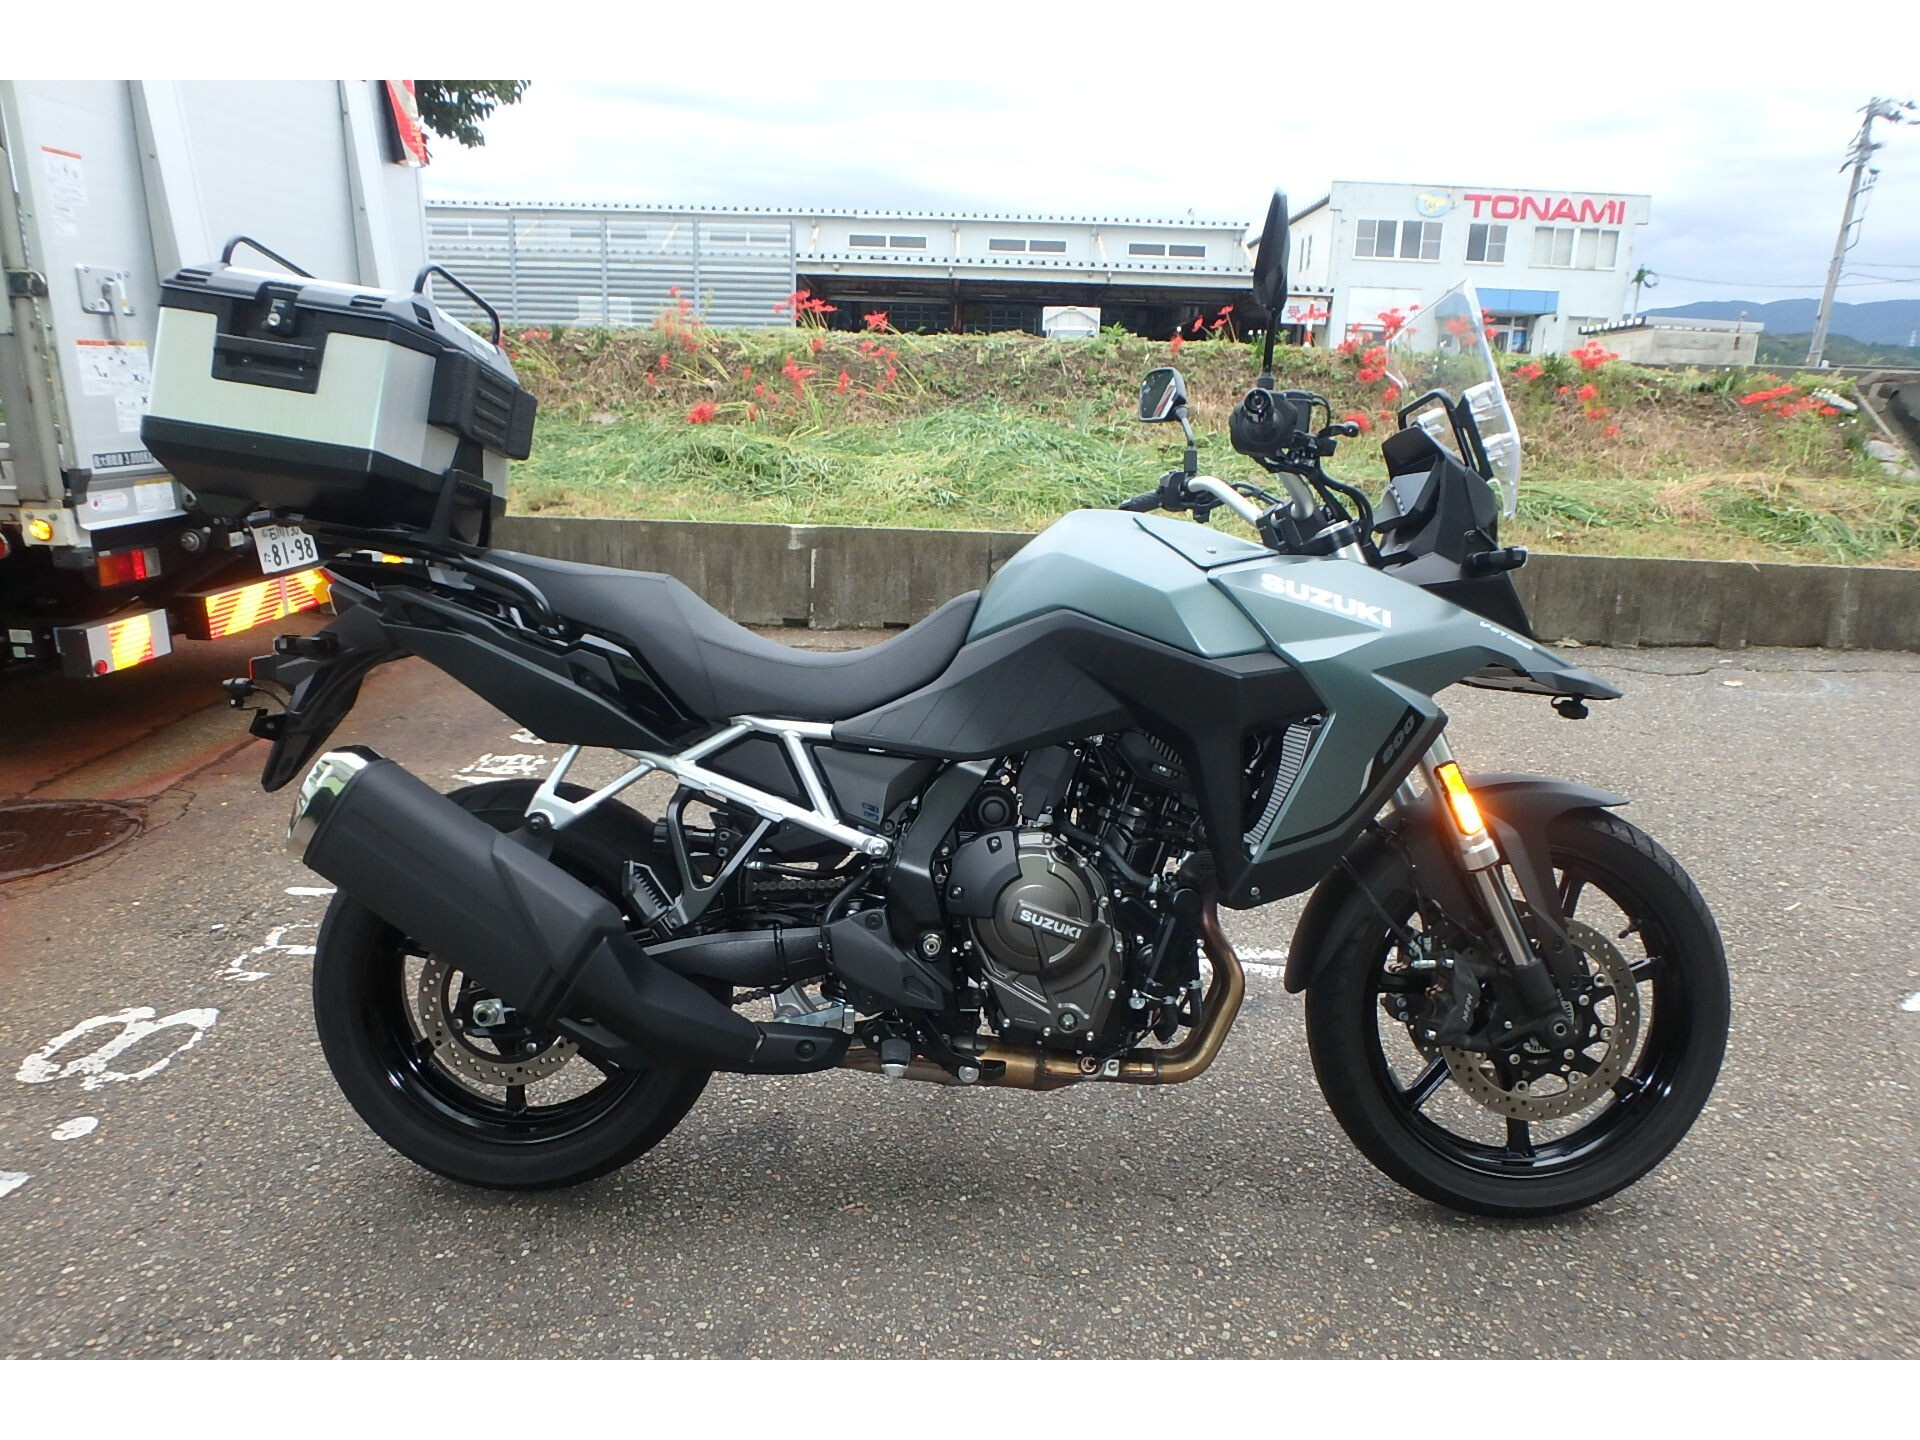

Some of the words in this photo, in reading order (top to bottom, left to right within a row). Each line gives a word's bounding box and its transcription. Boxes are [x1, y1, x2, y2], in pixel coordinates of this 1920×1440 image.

[1464, 193, 1626, 225] TONAMI
[271, 536, 314, 567] 81-98
[1261, 573, 1392, 629] SUZUKI
[1019, 909, 1082, 940] SUZUKI
